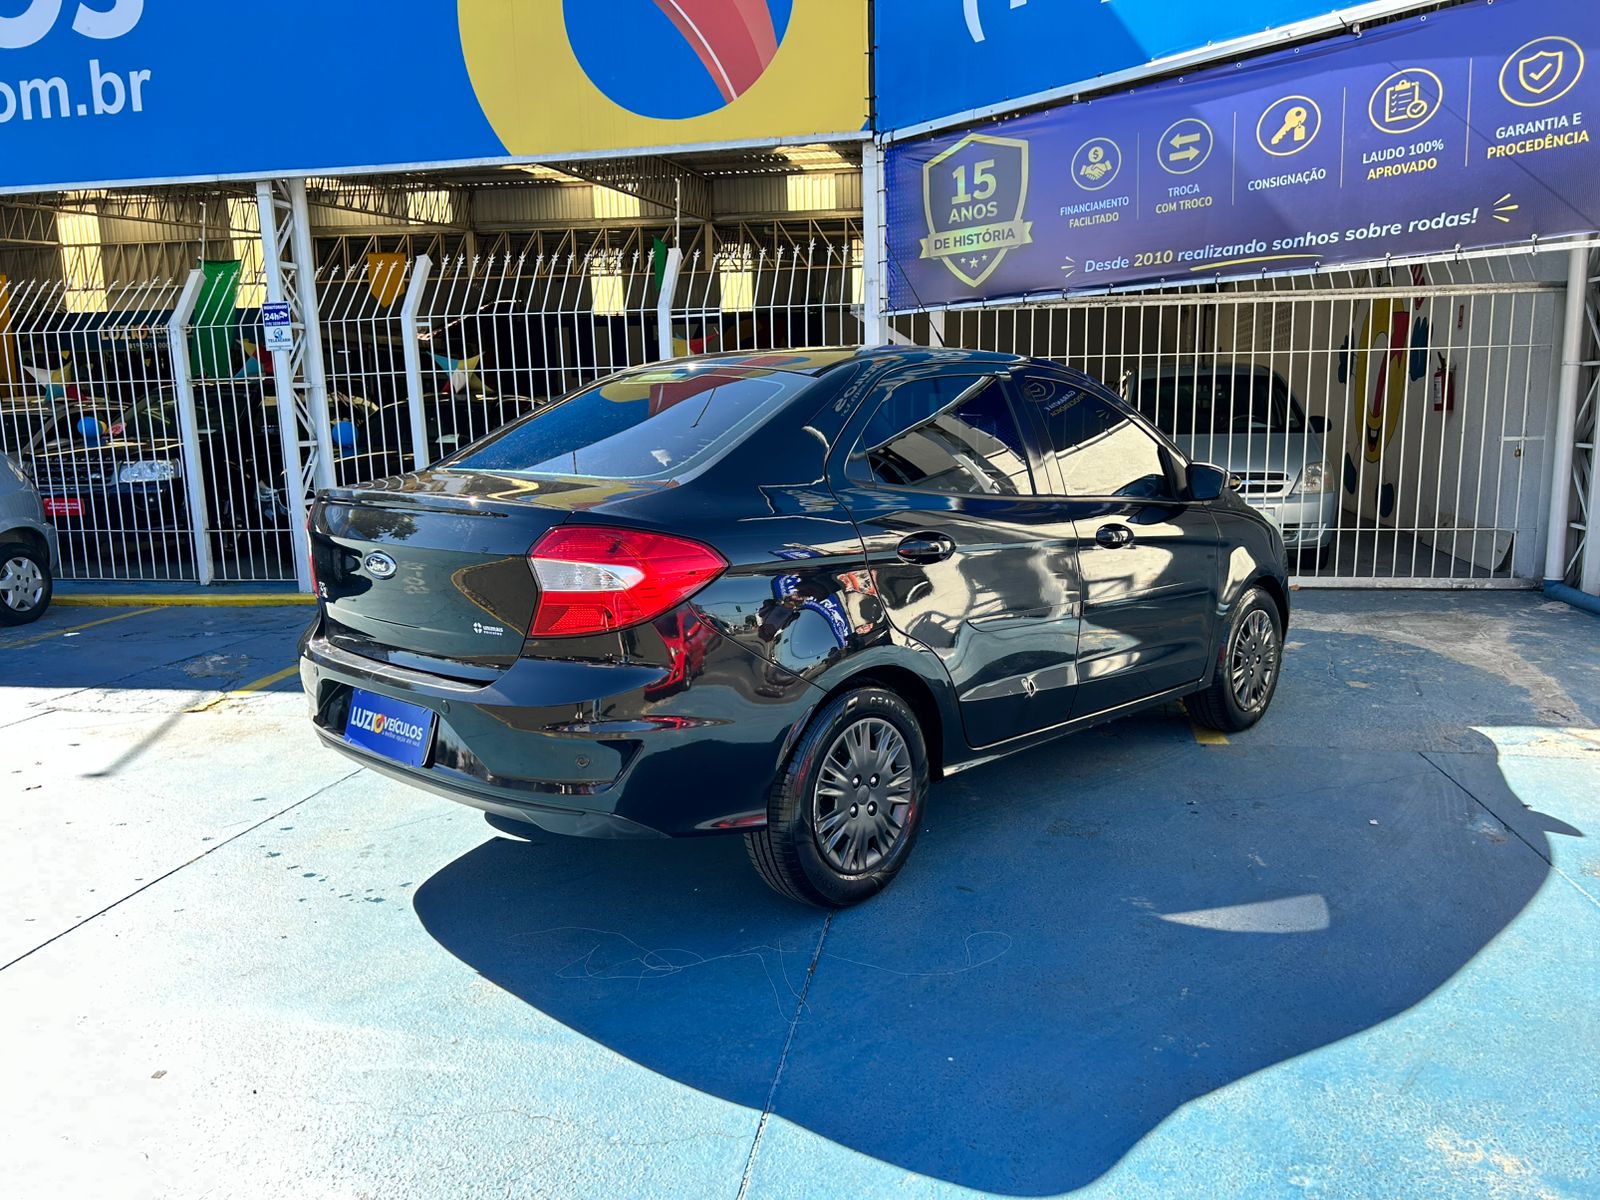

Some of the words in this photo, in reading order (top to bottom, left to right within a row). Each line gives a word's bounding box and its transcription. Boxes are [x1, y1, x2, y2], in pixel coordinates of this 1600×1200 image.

[1495, 115, 1568, 139] GARANTIA
[1572, 112, 1582, 125] E
[1362, 147, 1405, 164] LAUDO
[1409, 139, 1444, 157] 100%
[1487, 130, 1589, 159] PROCEDÊNCIA
[1247, 168, 1326, 192] CONSIGNAÇÃO
[1367, 158, 1437, 181] APROVADO
[951, 159, 997, 205] 15
[1168, 184, 1200, 197] TROCA
[948, 201, 997, 224] ANOS
[1060, 196, 1130, 216] FINANCIAMENTO
[1155, 200, 1178, 214] COM
[1180, 197, 1213, 211] TROCO
[1069, 212, 1119, 228] FACILITADO
[934, 237, 951, 251] DE
[953, 226, 1016, 248] HISTÓRIA
[1084, 257, 1129, 273] Desde
[1133, 250, 1174, 267] 2010
[1177, 240, 1267, 261] realizando
[1272, 228, 1339, 250] sonhos
[1344, 220, 1401, 241] sobre
[1408, 208, 1480, 233] rodas!
[264, 313, 280, 321] 24h
[384, 717, 423, 740] VEÍCULOS
